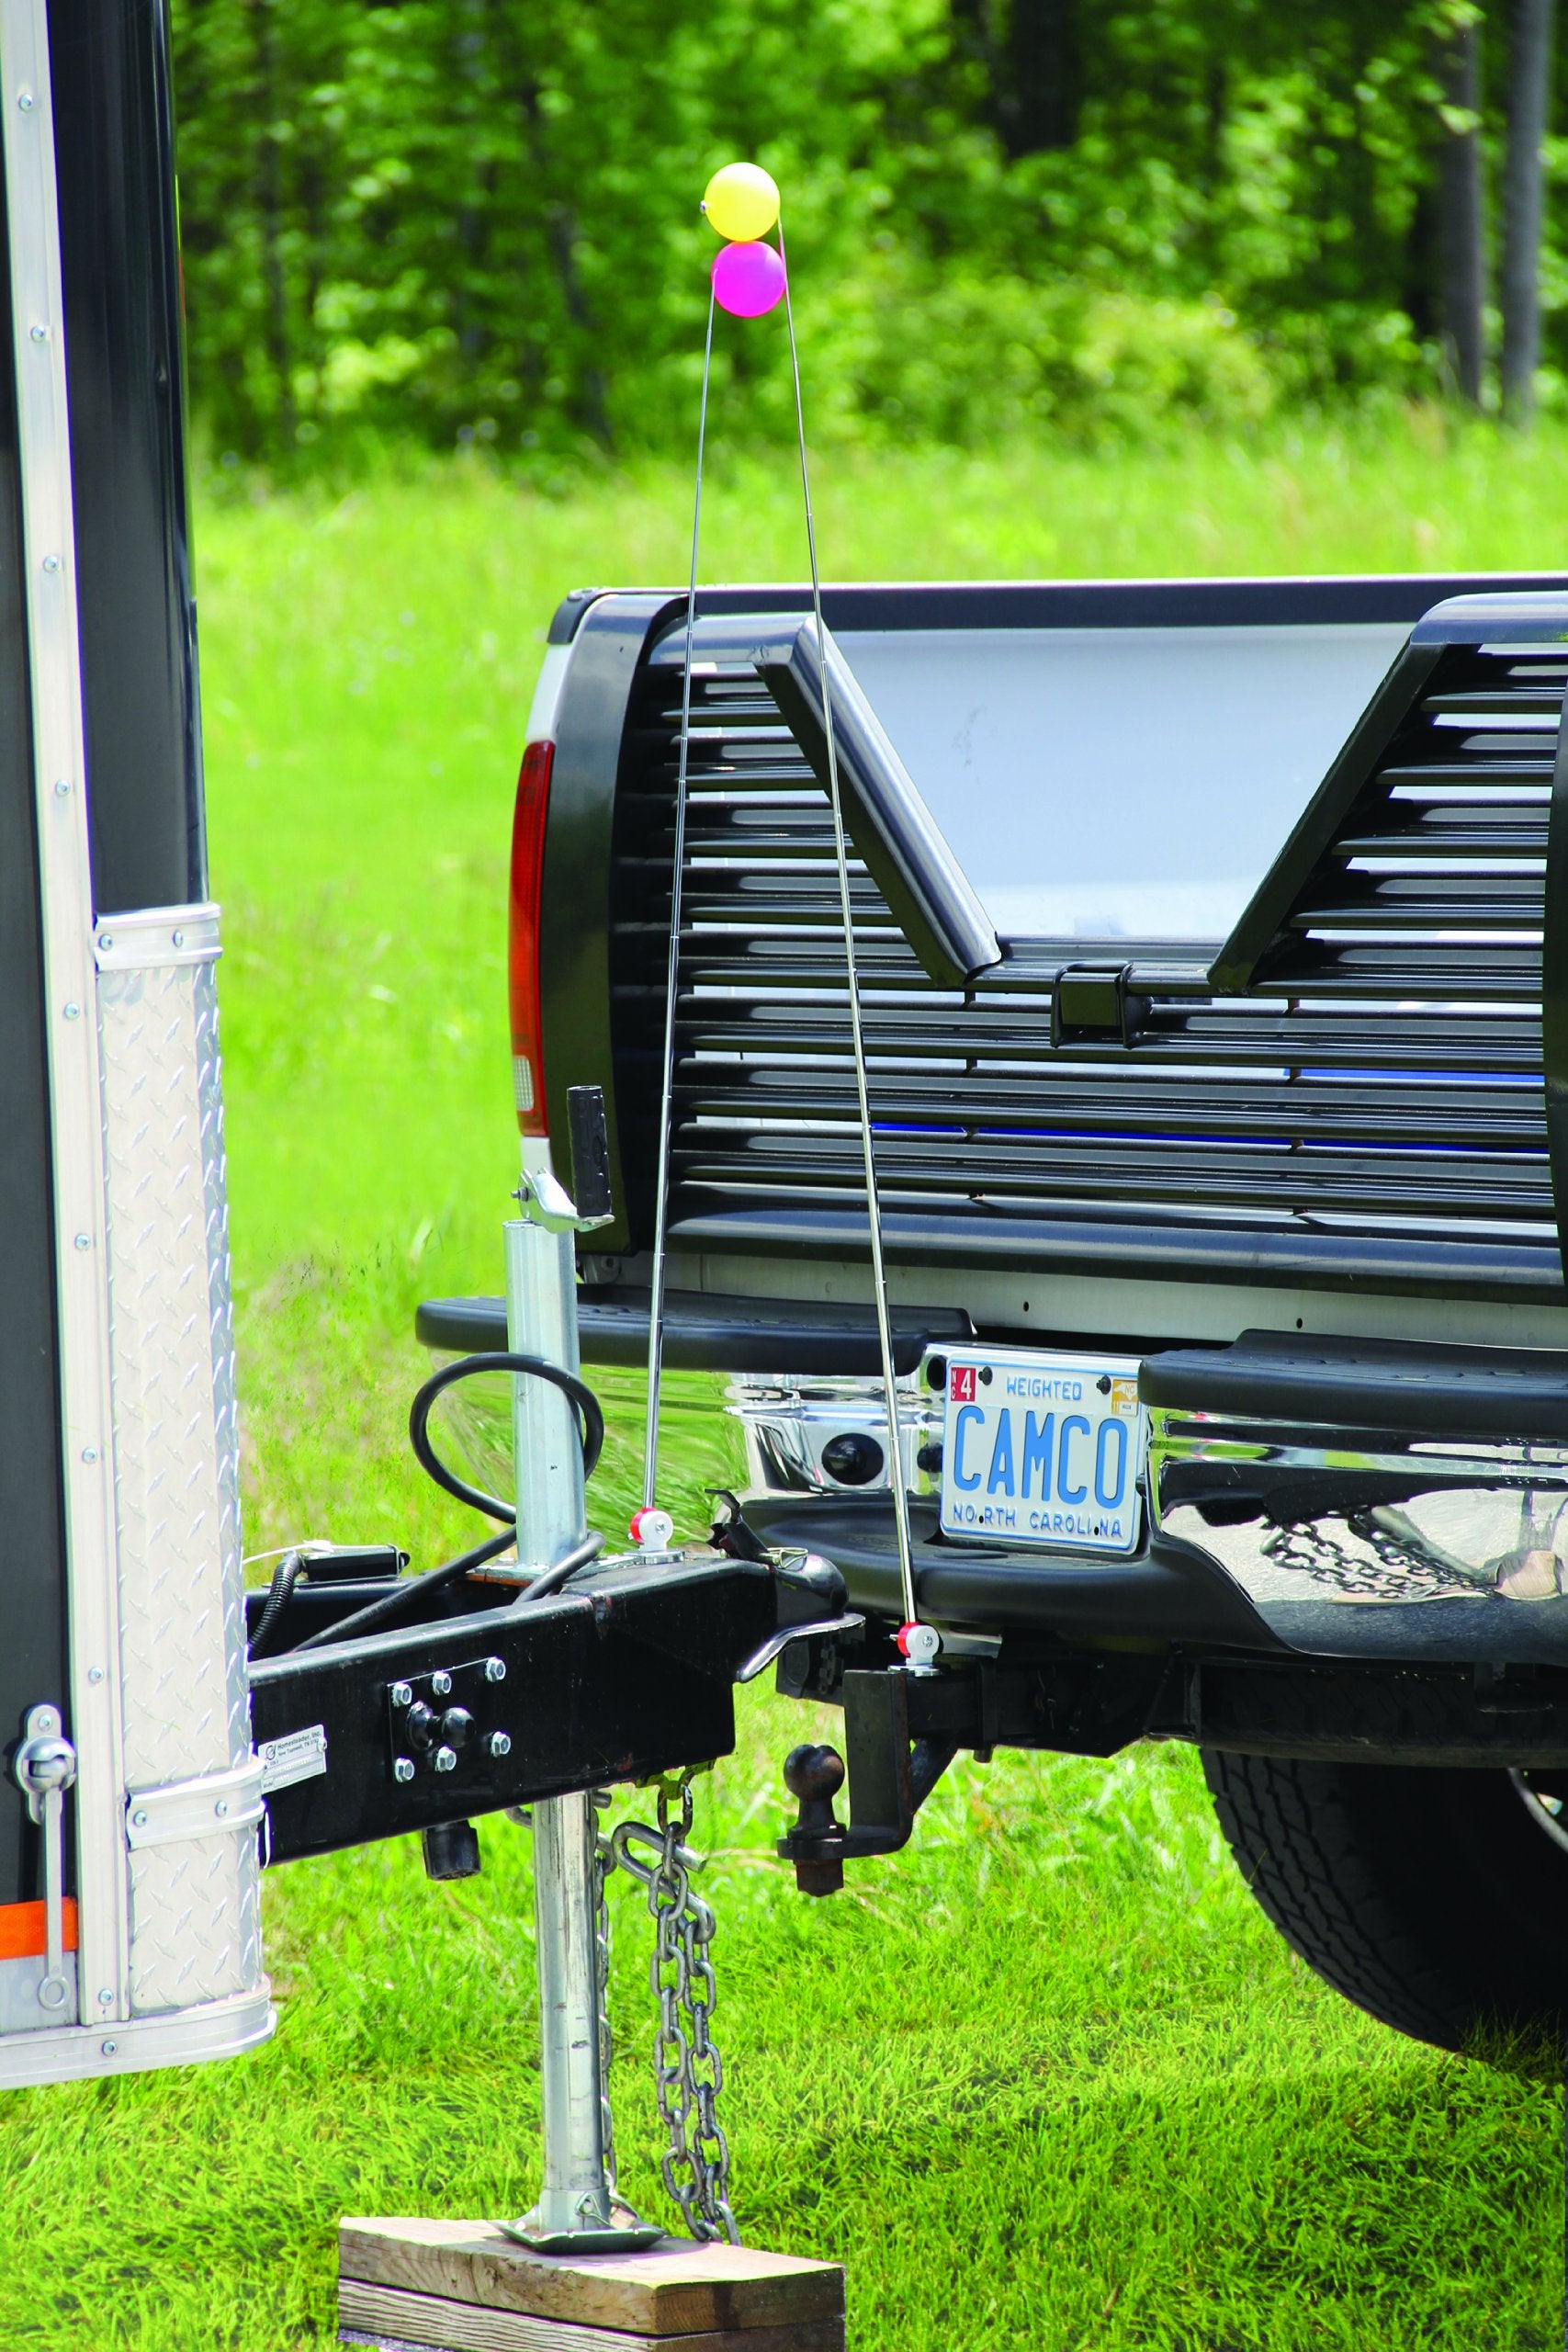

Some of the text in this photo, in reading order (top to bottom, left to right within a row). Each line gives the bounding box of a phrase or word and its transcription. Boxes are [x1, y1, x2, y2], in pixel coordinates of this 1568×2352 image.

[961, 1370, 972, 1400] 4
[1007, 1375, 1082, 1401] WEIGHTED
[953, 1405, 1128, 1509] CAMCO
[953, 1502, 1122, 1537] NORTH CAROLINA
